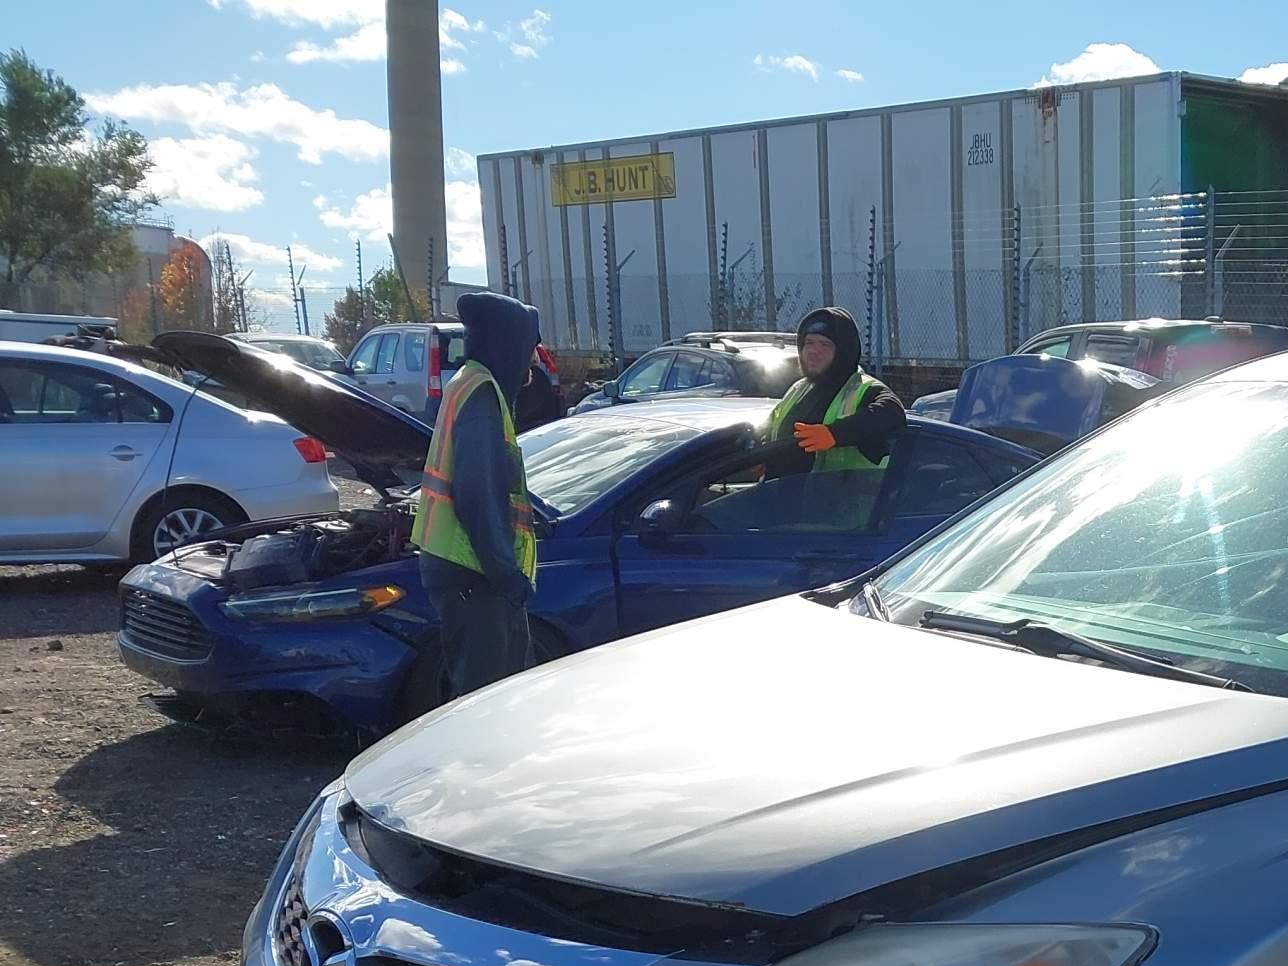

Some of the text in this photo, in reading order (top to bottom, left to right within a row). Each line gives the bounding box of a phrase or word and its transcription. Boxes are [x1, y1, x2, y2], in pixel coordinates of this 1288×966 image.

[970, 132, 992, 150] JBHU
[967, 148, 994, 166] 212338
[604, 165, 649, 192] HUNT
